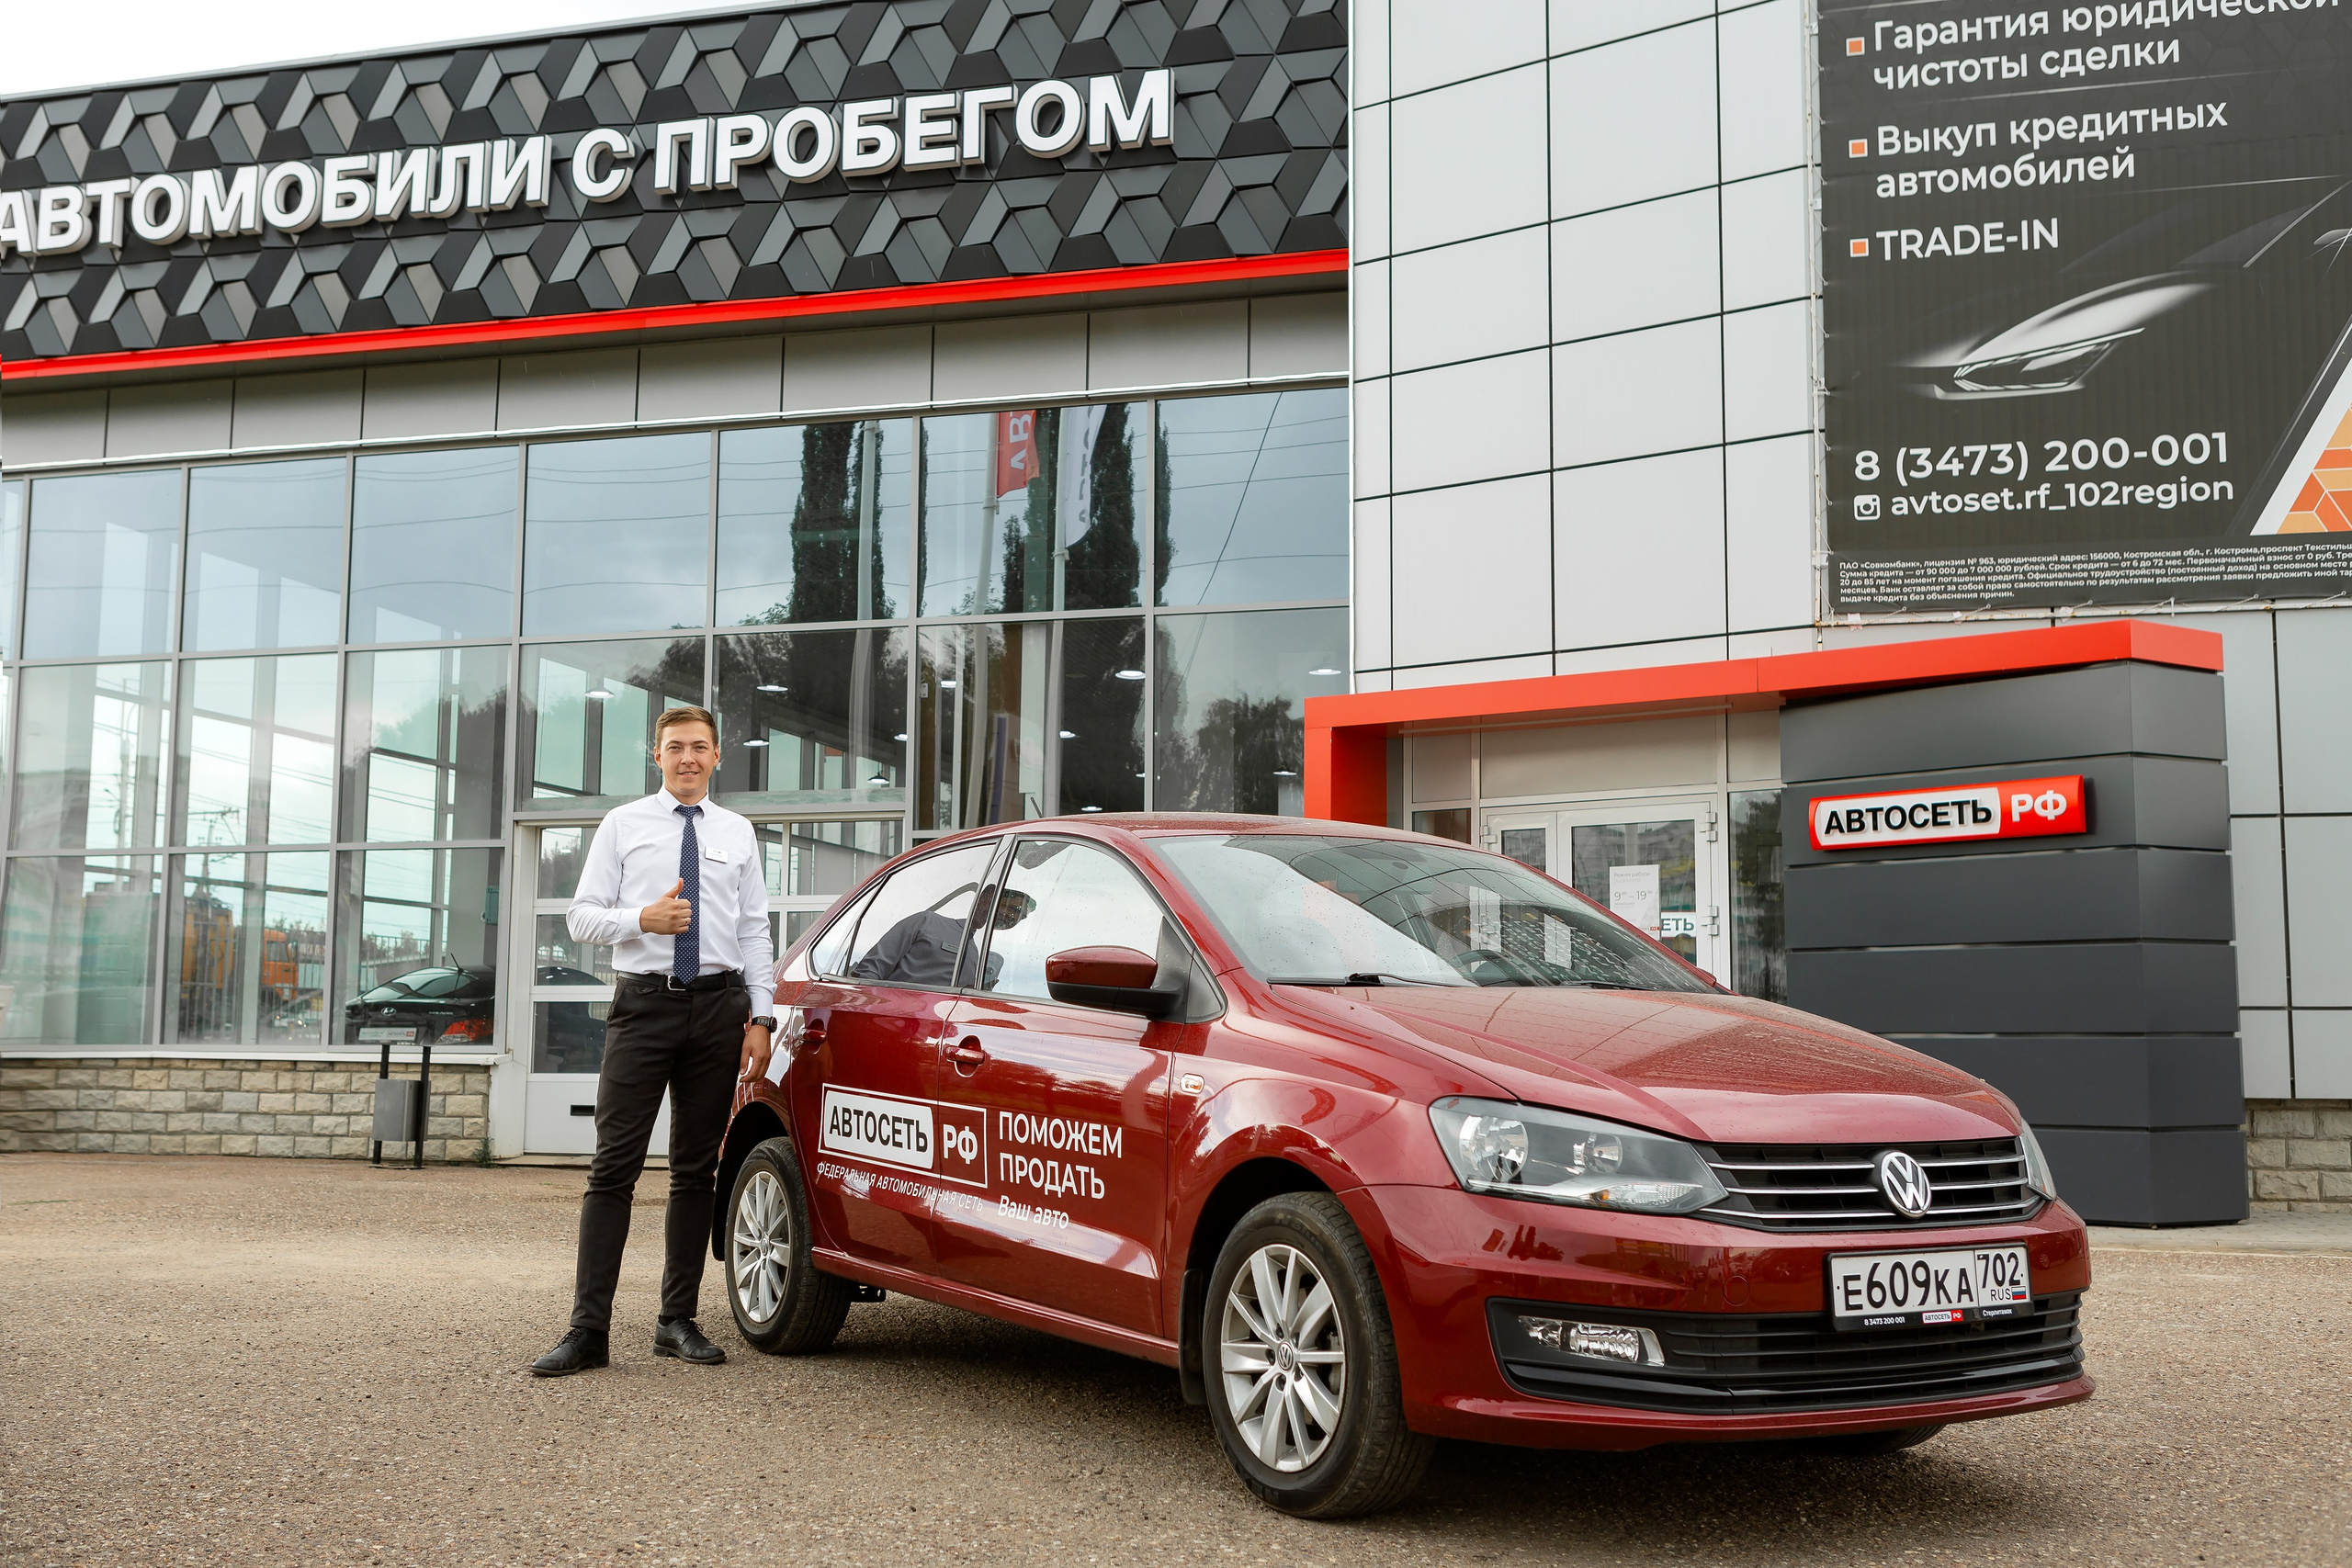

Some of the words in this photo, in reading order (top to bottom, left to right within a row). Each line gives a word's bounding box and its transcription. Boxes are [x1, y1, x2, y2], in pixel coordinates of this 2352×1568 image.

[1874, 10, 2049, 55] Гарантия
[1873, 52, 2028, 91] чистоты
[2040, 39, 2180, 79] сделки
[1877, 121, 1997, 158] Выкуп
[2009, 101, 2229, 151] кредитных
[0, 134, 552, 257] АВТОМОБИЛИ
[571, 128, 634, 202] С
[653, 68, 1174, 196] ПРОБЕГОМ
[1876, 145, 2135, 198] автомобилей
[1875, 217, 2059, 262] TRADE-IN
[1854, 449, 1881, 481] 8
[1895, 440, 2029, 487] (3473)
[2043, 431, 2227, 472] 200-001
[1891, 475, 2233, 516] avtoset.rf_102region
[1839, 570, 1867, 581] Сумма
[1869, 570, 1904, 580] кредита
[2013, 562, 2047, 574] рублей.
[2048, 562, 2071, 573] Срок
[2072, 561, 2109, 572] кредита
[2186, 554, 2265, 568] Первоначальный
[2314, 550, 2335, 560] руб.
[1904, 576, 1936, 584] момент
[1987, 573, 2025, 582] кредита.
[2026, 569, 2088, 582] Официальное
[2089, 567, 2165, 580] трудоустройство
[2167, 564, 2225, 576] (постоянный
[2226, 562, 2257, 574] доход)
[2272, 561, 2318, 570] основном
[1923, 558, 1965, 567] лицензия
[1978, 557, 1996, 565] 963,
[1997, 554, 2058, 567] юридический
[2059, 554, 2088, 562] адрес:
[2089, 551, 2121, 560] 156000,
[2123, 549, 2181, 561] Костромская
[2182, 547, 2204, 556] обл.,
[1872, 594, 1907, 603] кредита
[1926, 588, 1977, 600] объяснения
[1979, 590, 2015, 600] причин.
[1879, 585, 1901, 593] Банк
[1902, 584, 1945, 592] оставляет
[1957, 581, 1984, 591] собой
[1985, 581, 2012, 591] право
[2013, 579, 2085, 588] самостоятельно
[2098, 577, 2154, 586] результатам
[2155, 573, 2221, 584] рассмотрения
[2222, 572, 2254, 581] заявки
[2256, 570, 2312, 581] предложить
[2313, 569, 2337, 577] иной
[1824, 799, 1992, 835] АВТОСЕТЬ
[2010, 789, 2067, 822] РФ
[829, 1105, 928, 1153] АВТОСЕТЬ
[943, 1123, 978, 1165] РФ
[999, 1111, 1123, 1159] ПОМОЖЕМ
[817, 1161, 876, 1186] ФЕДЕРАЛЬНАЯ
[876, 1175, 956, 1205] АВТОМОБИЛЬНАЯ
[958, 1193, 984, 1212] СЕТЬ
[1000, 1152, 1105, 1200] ПРОДАТЬ
[997, 1195, 1031, 1220] Ваш
[1034, 1207, 1069, 1230] авто
[1976, 1252, 2021, 1289] 702
[1990, 1288, 2011, 1301] RUS
[1869, 1317, 1883, 1325] 3473
[1924, 1313, 1951, 1322] АВТОСЕТЬ
